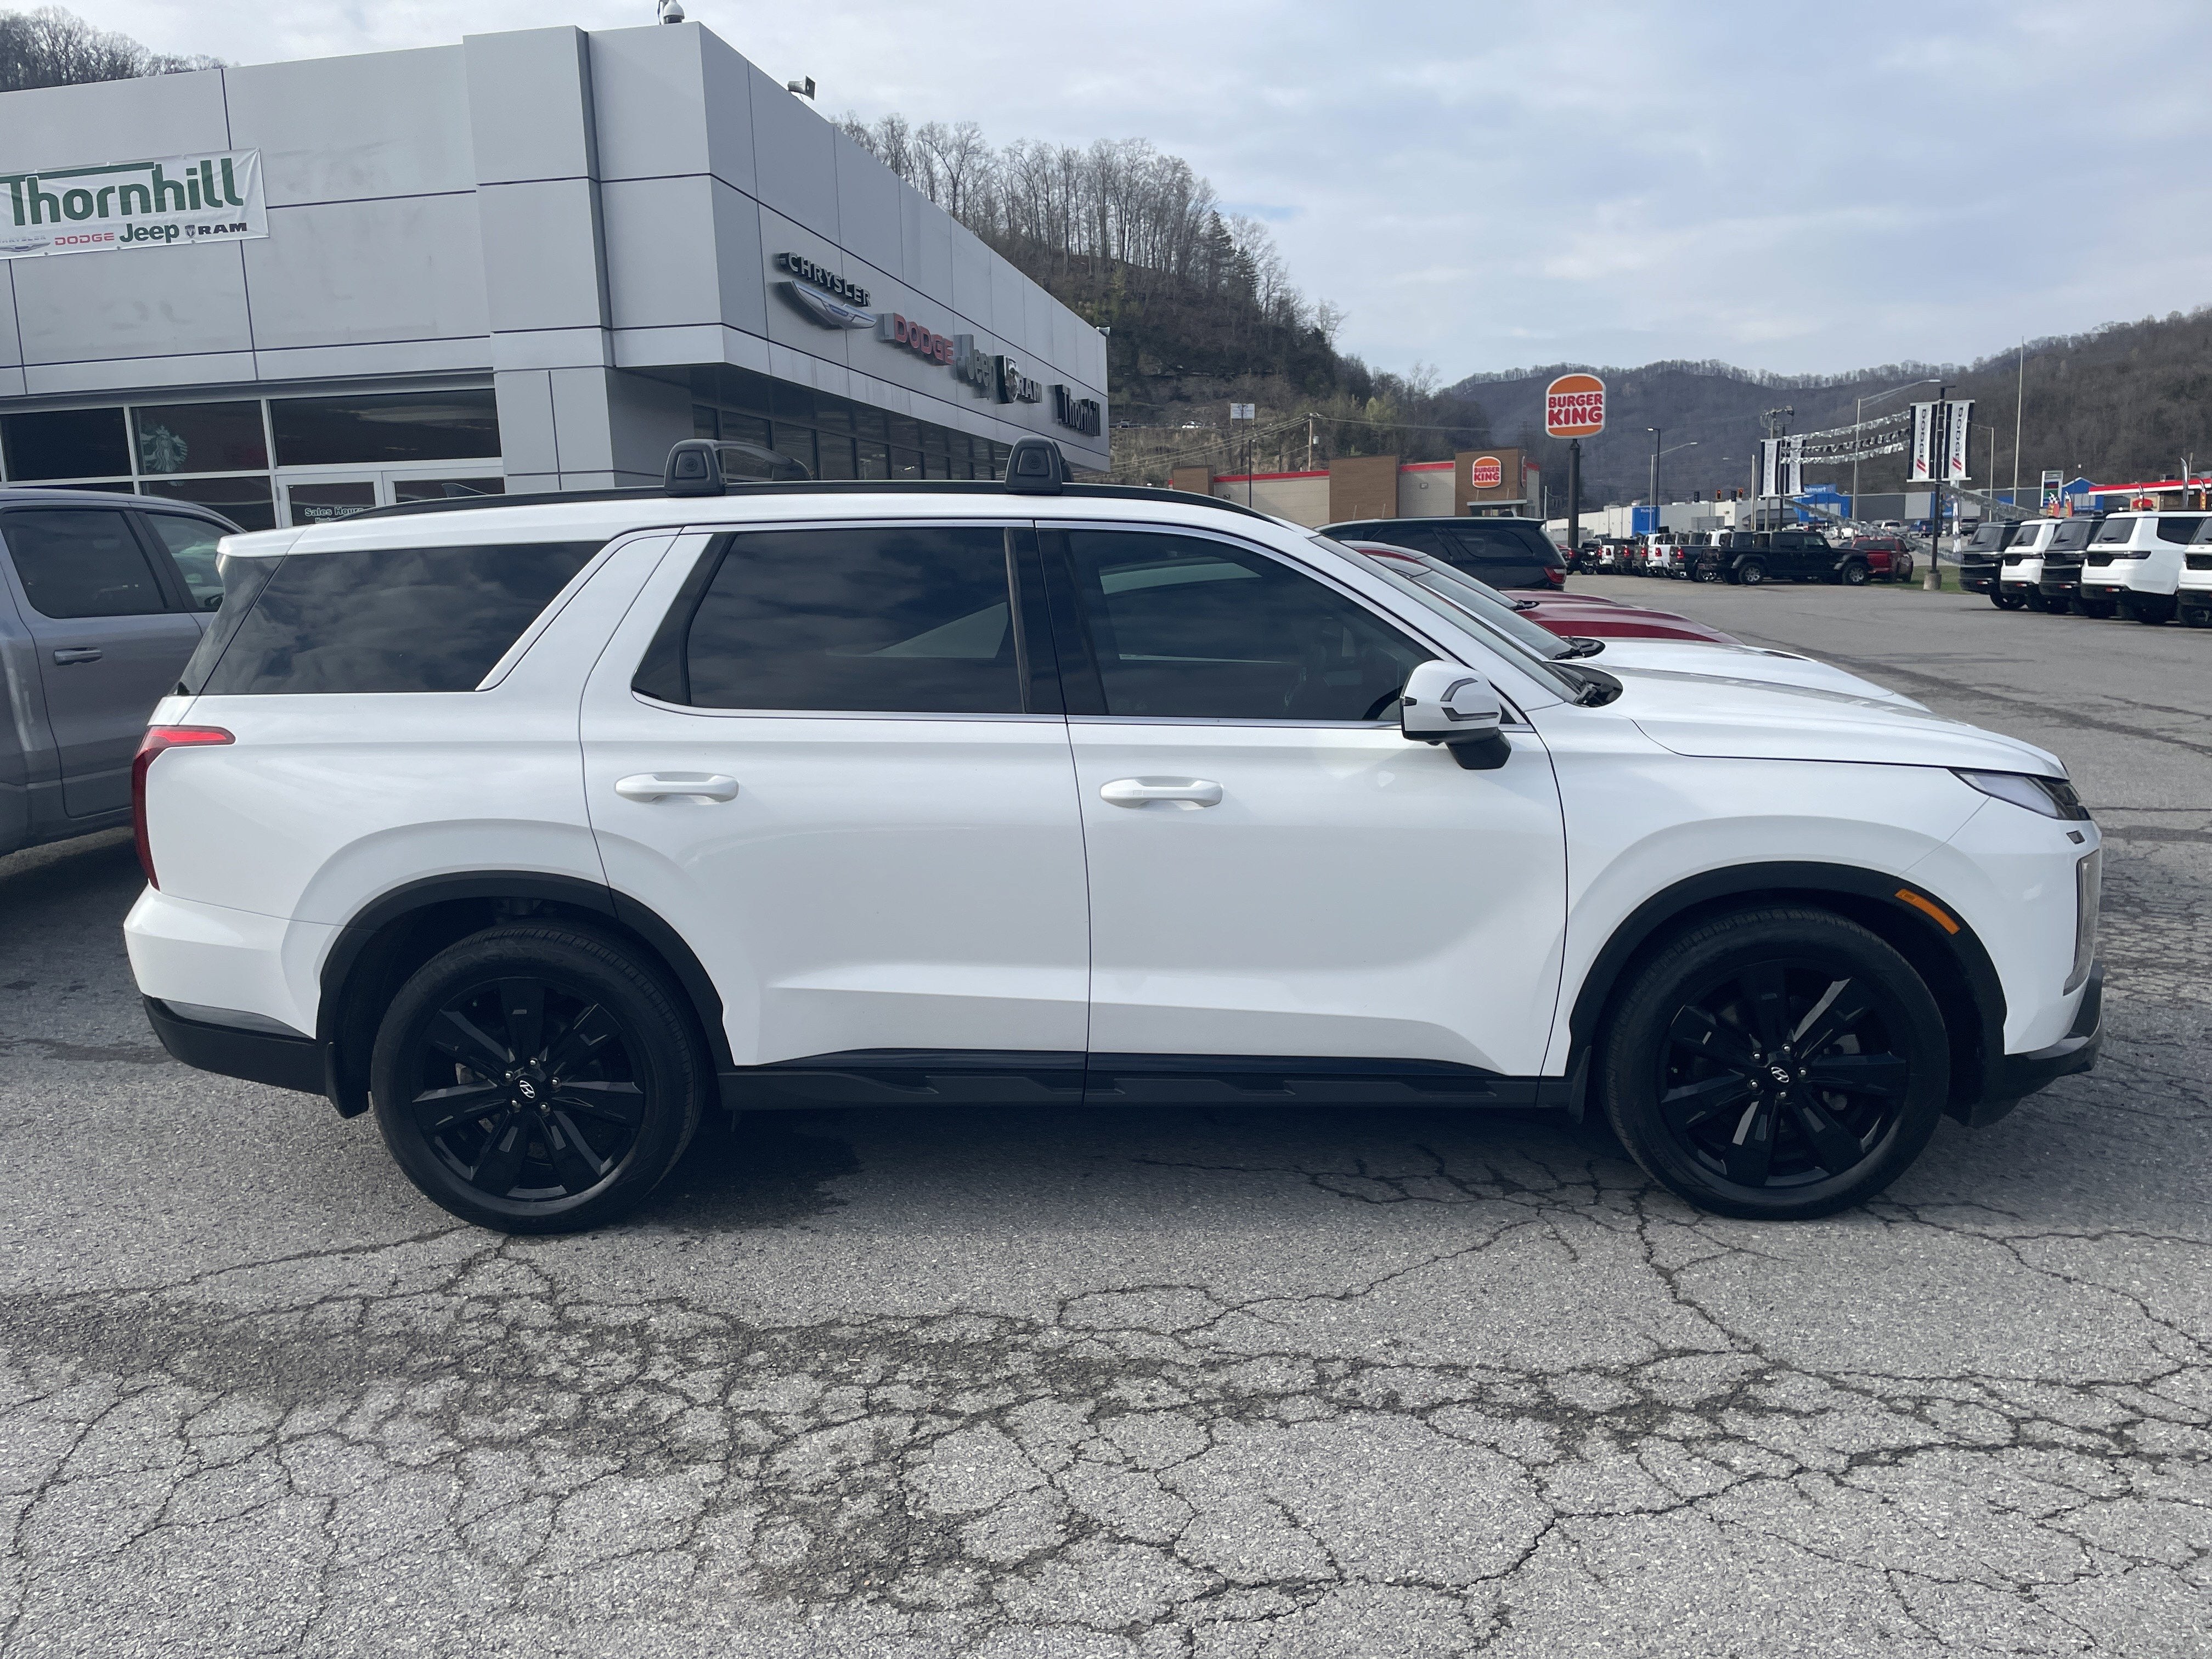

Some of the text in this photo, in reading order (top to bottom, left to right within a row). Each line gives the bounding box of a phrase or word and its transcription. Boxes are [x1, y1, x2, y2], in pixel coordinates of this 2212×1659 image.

[0, 158, 244, 226] Thornhill
[55, 233, 115, 246] DODGE
[120, 223, 180, 243] Jeep
[198, 222, 247, 236] RAM
[788, 251, 871, 307] CHRYSLER
[893, 312, 955, 365] DODGE
[1018, 373, 1042, 403] RAM
[1549, 393, 1602, 408] BURGER
[1549, 406, 1602, 426] KING
[1474, 472, 1500, 481] KING
[304, 507, 332, 517] Sales
